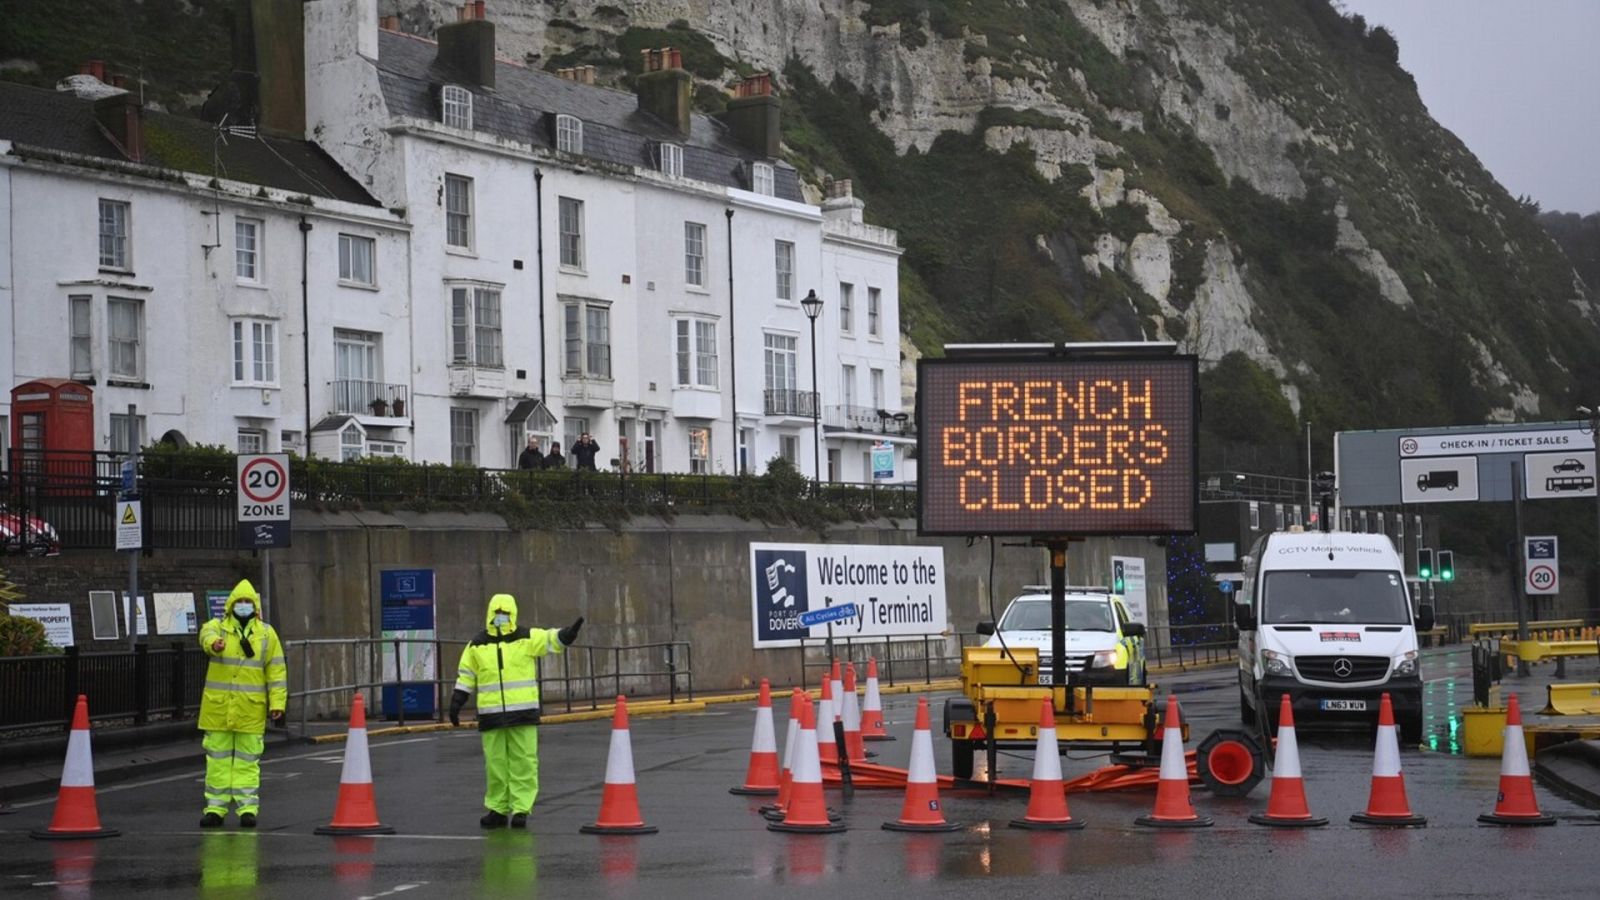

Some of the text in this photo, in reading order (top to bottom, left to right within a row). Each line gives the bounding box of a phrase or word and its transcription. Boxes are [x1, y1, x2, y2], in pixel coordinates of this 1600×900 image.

[960, 379, 1151, 421] FRENCH
[943, 424, 1168, 466] BORDERS
[1440, 439, 1489, 449] CHECK-IN
[1499, 437, 1533, 447] TICKET
[1536, 435, 1569, 445] SALES
[248, 469, 280, 488] 20
[960, 469, 1152, 510] CLOSED
[243, 504, 285, 517] ZONE
[1278, 546, 1308, 555] CCTV
[1346, 546, 1382, 554] Vehicle
[817, 555, 936, 585] Welcome to the
[1534, 572, 1551, 583] 20
[768, 610, 787, 618] PORT
[816, 610, 837, 621] Cycles
[868, 594, 933, 625] Terminal
[769, 618, 799, 631] DOVER
[1325, 700, 1347, 710] LN63
